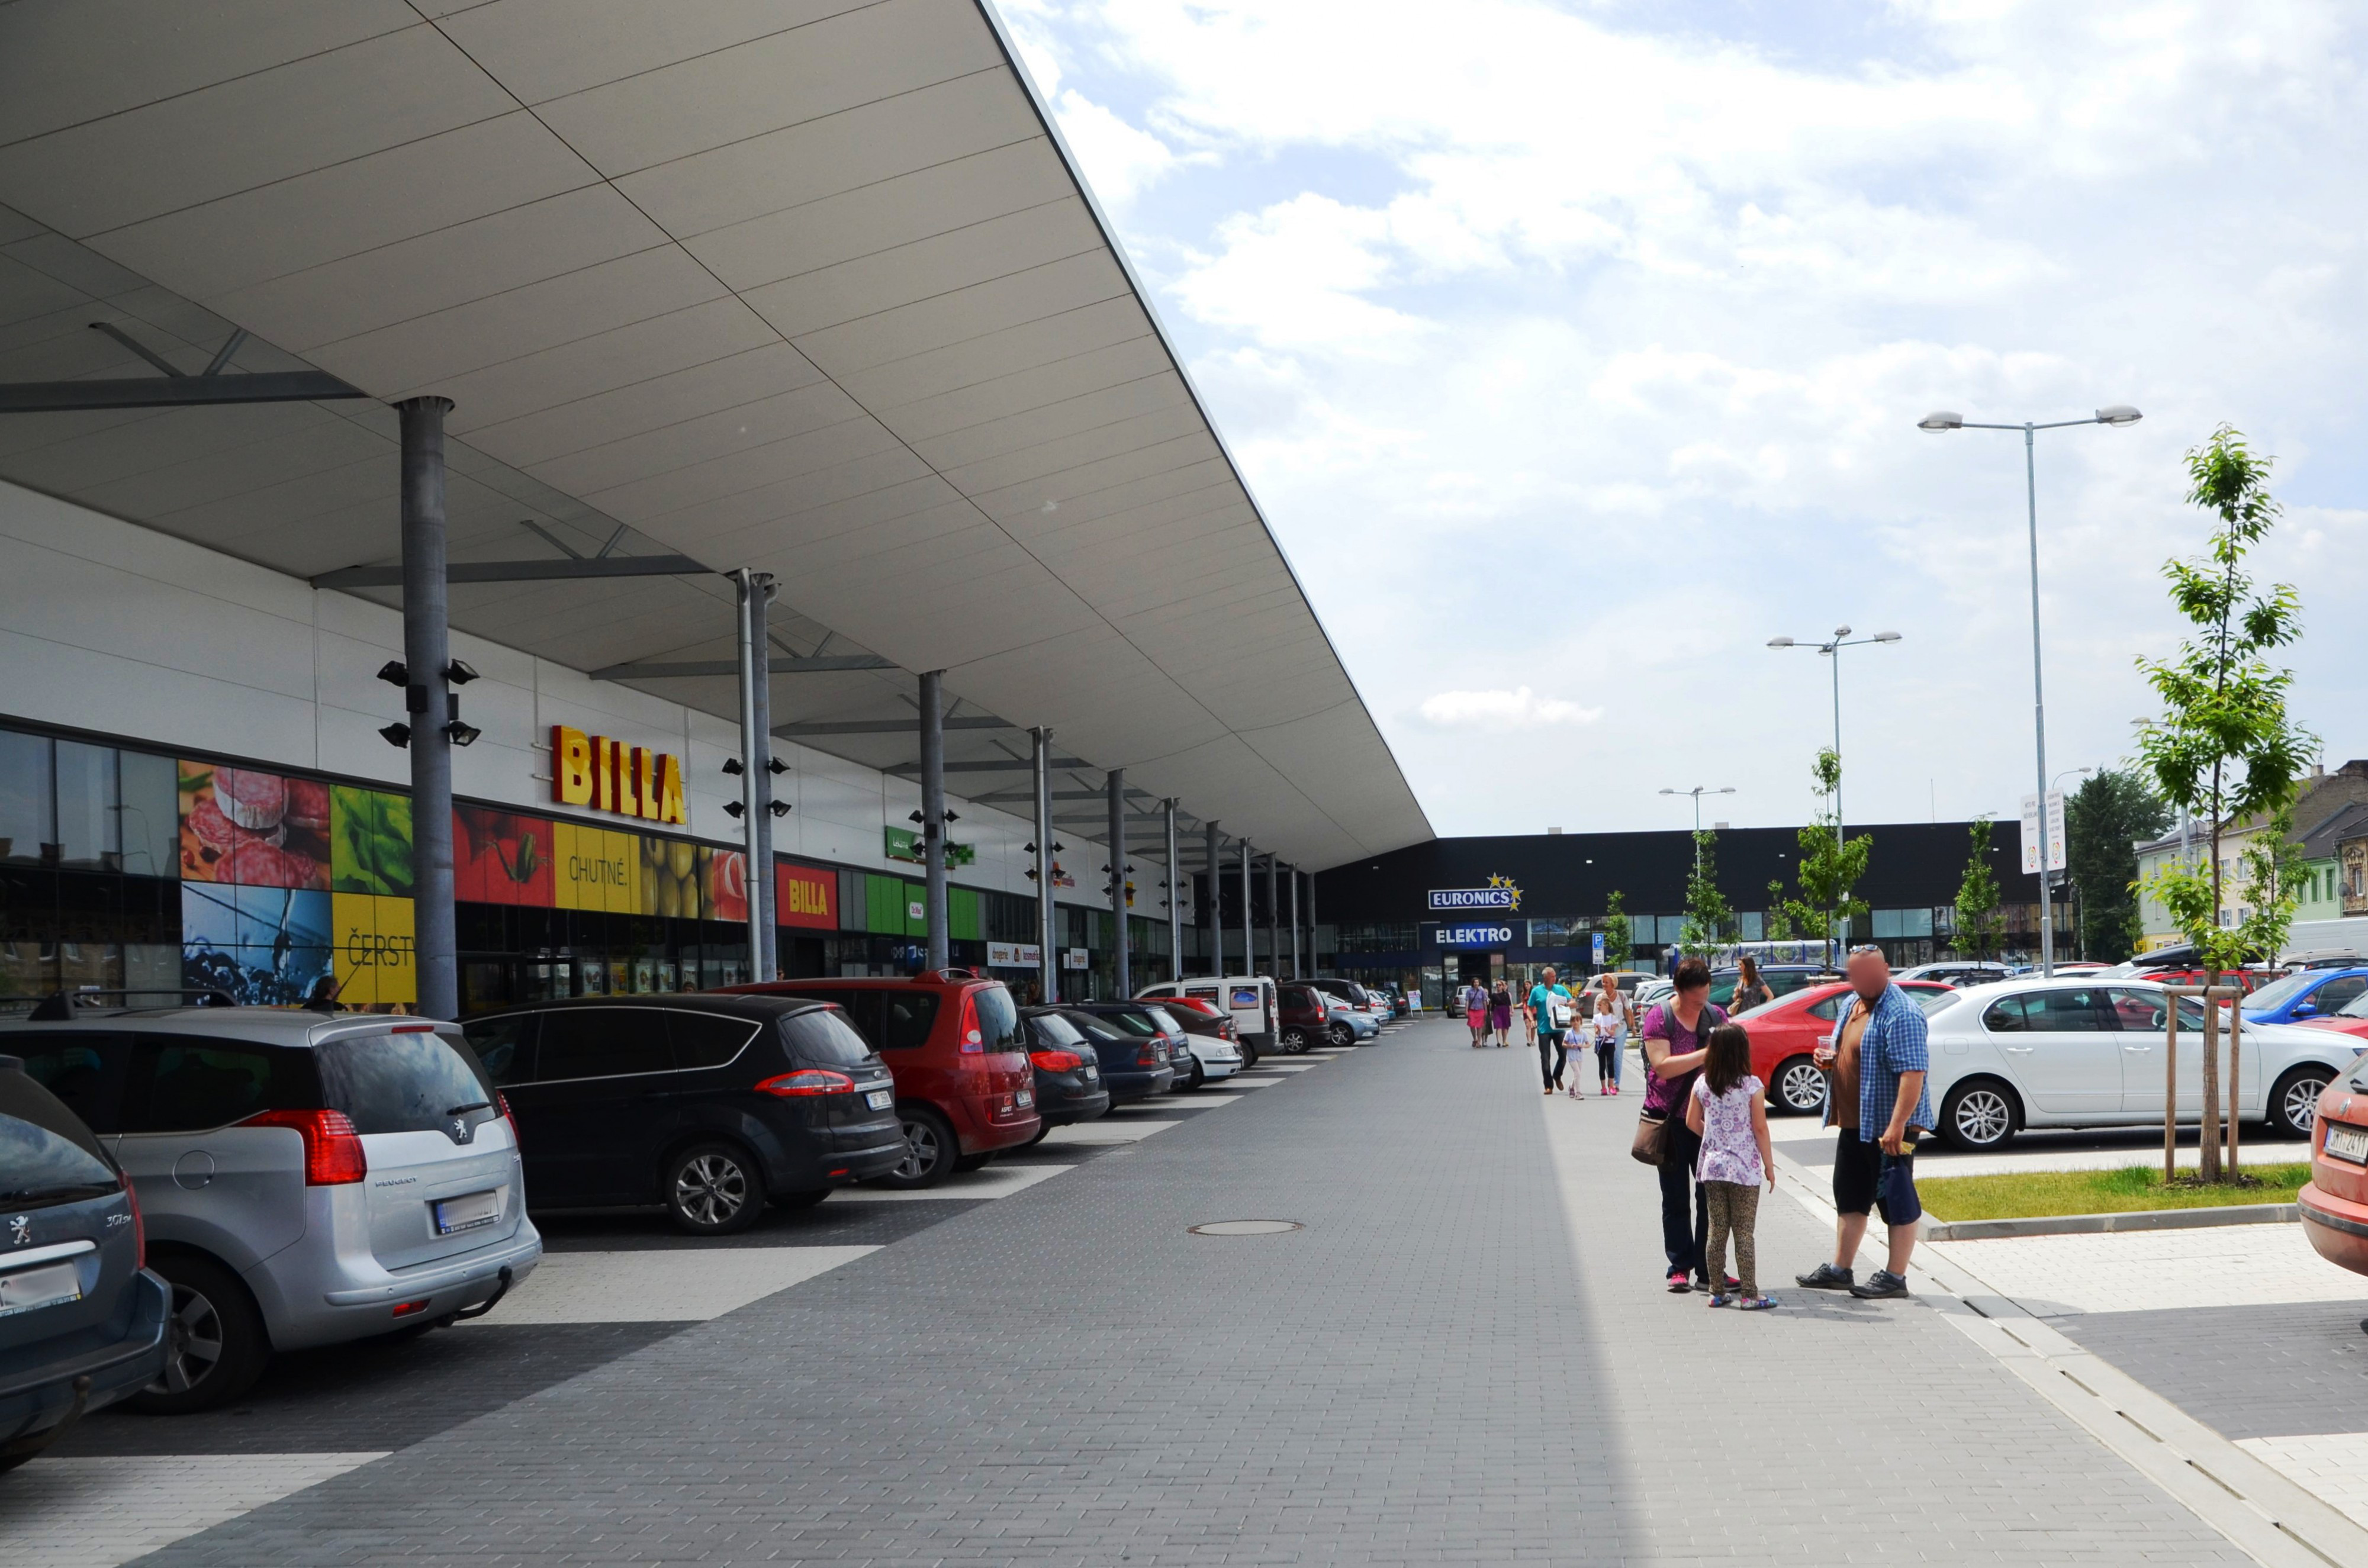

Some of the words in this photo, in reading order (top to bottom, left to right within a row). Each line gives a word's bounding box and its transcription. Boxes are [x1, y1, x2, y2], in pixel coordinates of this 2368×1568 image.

[552, 725, 686, 825] BILLA
[570, 856, 628, 886] CHUTNÉ.
[789, 879, 828, 916] BILLA
[1433, 891, 1510, 906] EURONICS
[1436, 928, 1512, 944] ELEKTRO
[1595, 935, 1602, 945] P
[992, 946, 1008, 962] drogerie
[2346, 1131, 2366, 1155] 2411
[375, 1176, 417, 1187] PEUGEOT
[107, 1214, 123, 1227] 307
